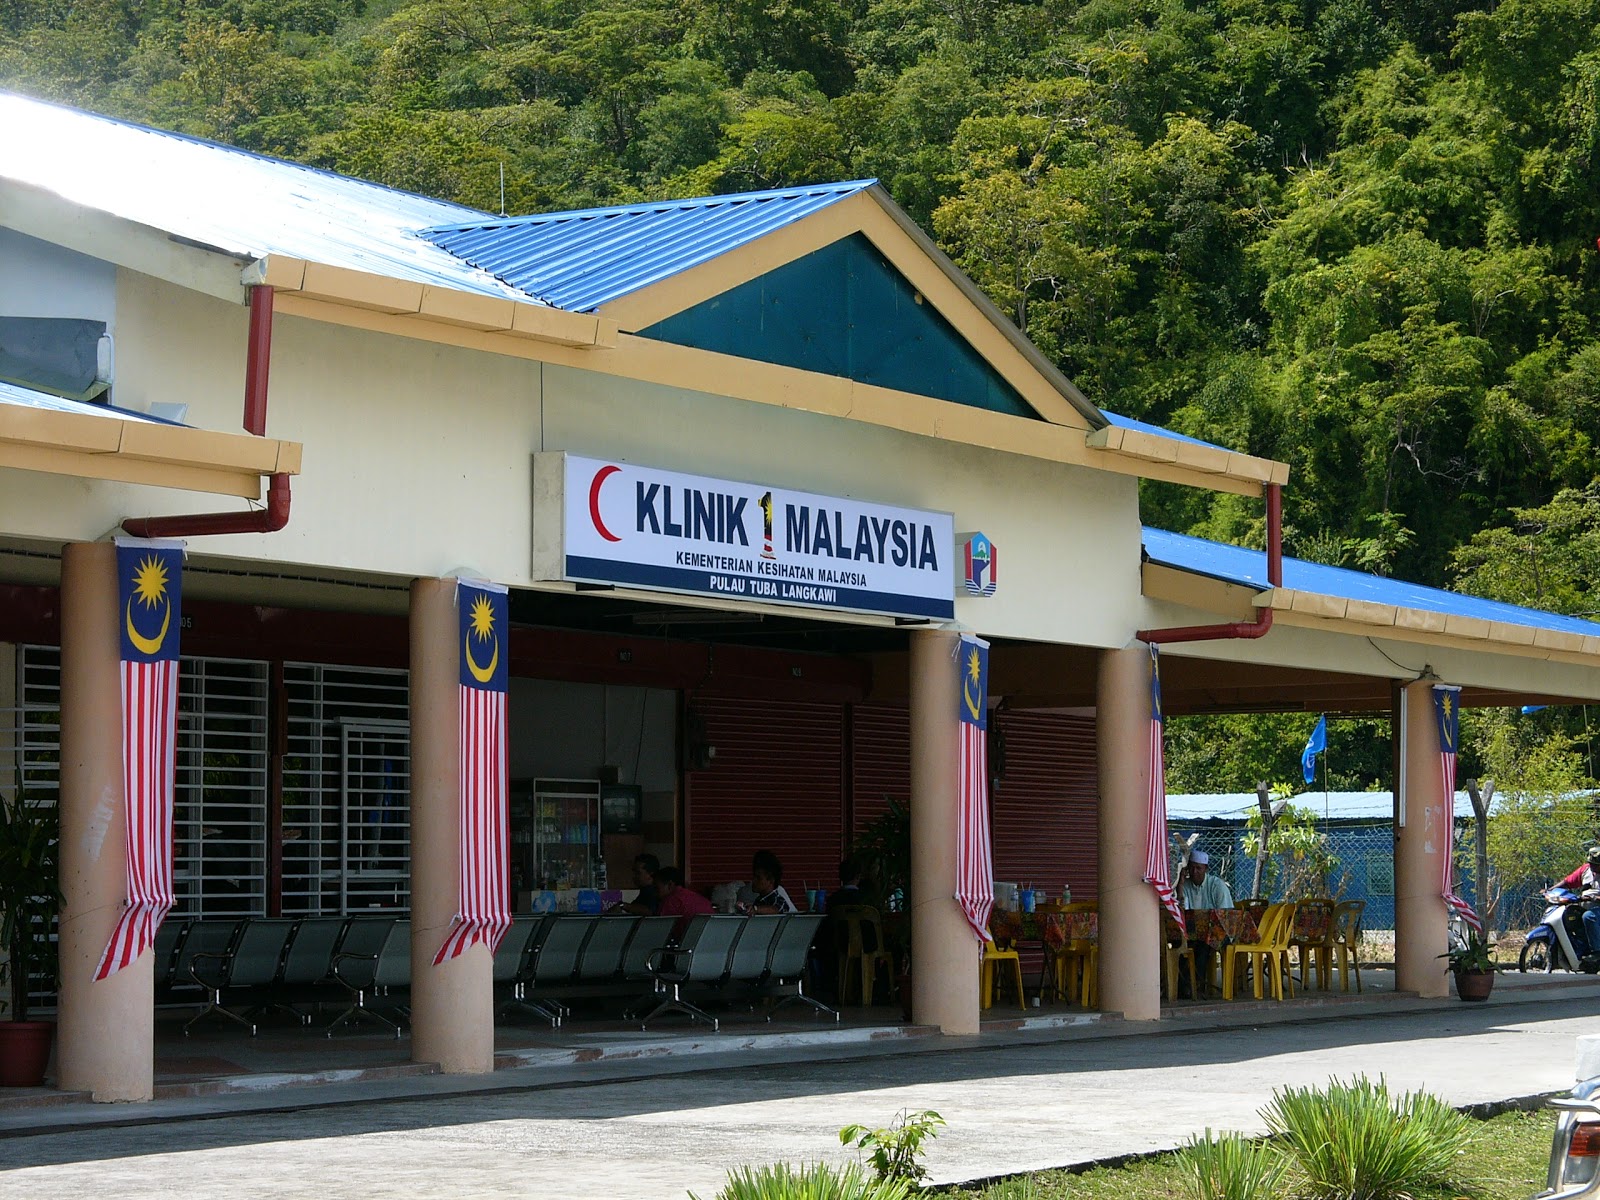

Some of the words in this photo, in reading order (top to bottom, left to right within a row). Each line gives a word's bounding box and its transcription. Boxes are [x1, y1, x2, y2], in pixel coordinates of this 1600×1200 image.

[636, 481, 750, 547] KLINIK
[757, 491, 777, 560] 1
[785, 503, 939, 572] MALAYSIA
[676, 551, 753, 573] KEMENTERIAN
[757, 561, 814, 581] KESIHATAN
[818, 568, 867, 587] MALAYSIA
[710, 575, 746, 593] PULAU
[750, 580, 778, 597] TUBA
[782, 583, 837, 603] LANGKAWI
